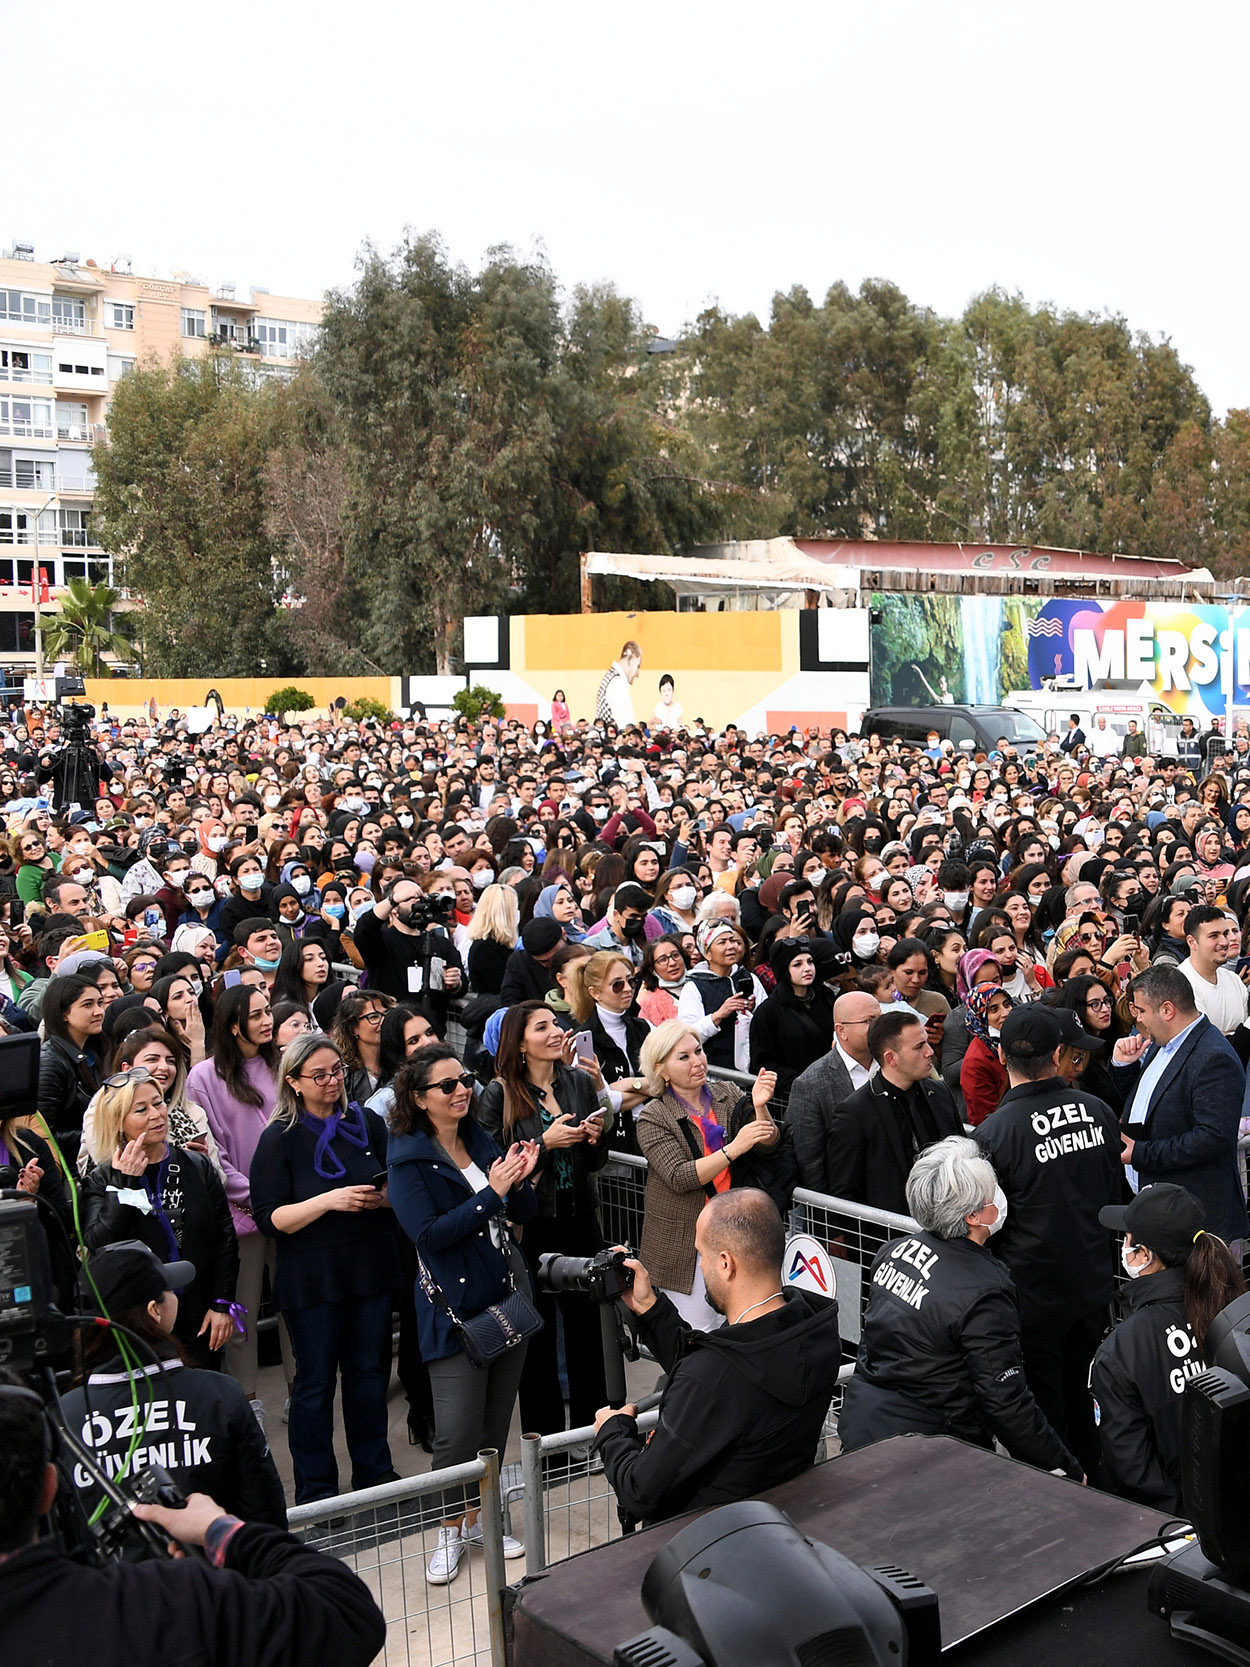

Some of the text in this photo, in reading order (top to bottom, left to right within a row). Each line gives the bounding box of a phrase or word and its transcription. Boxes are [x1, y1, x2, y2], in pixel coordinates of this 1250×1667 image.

[1030, 1102, 1095, 1136] ÖZEL
[1034, 1123, 1106, 1164] GÜVENLİK
[872, 1261, 930, 1311] GÜVENLİK
[81, 1400, 196, 1448] ÖZEL
